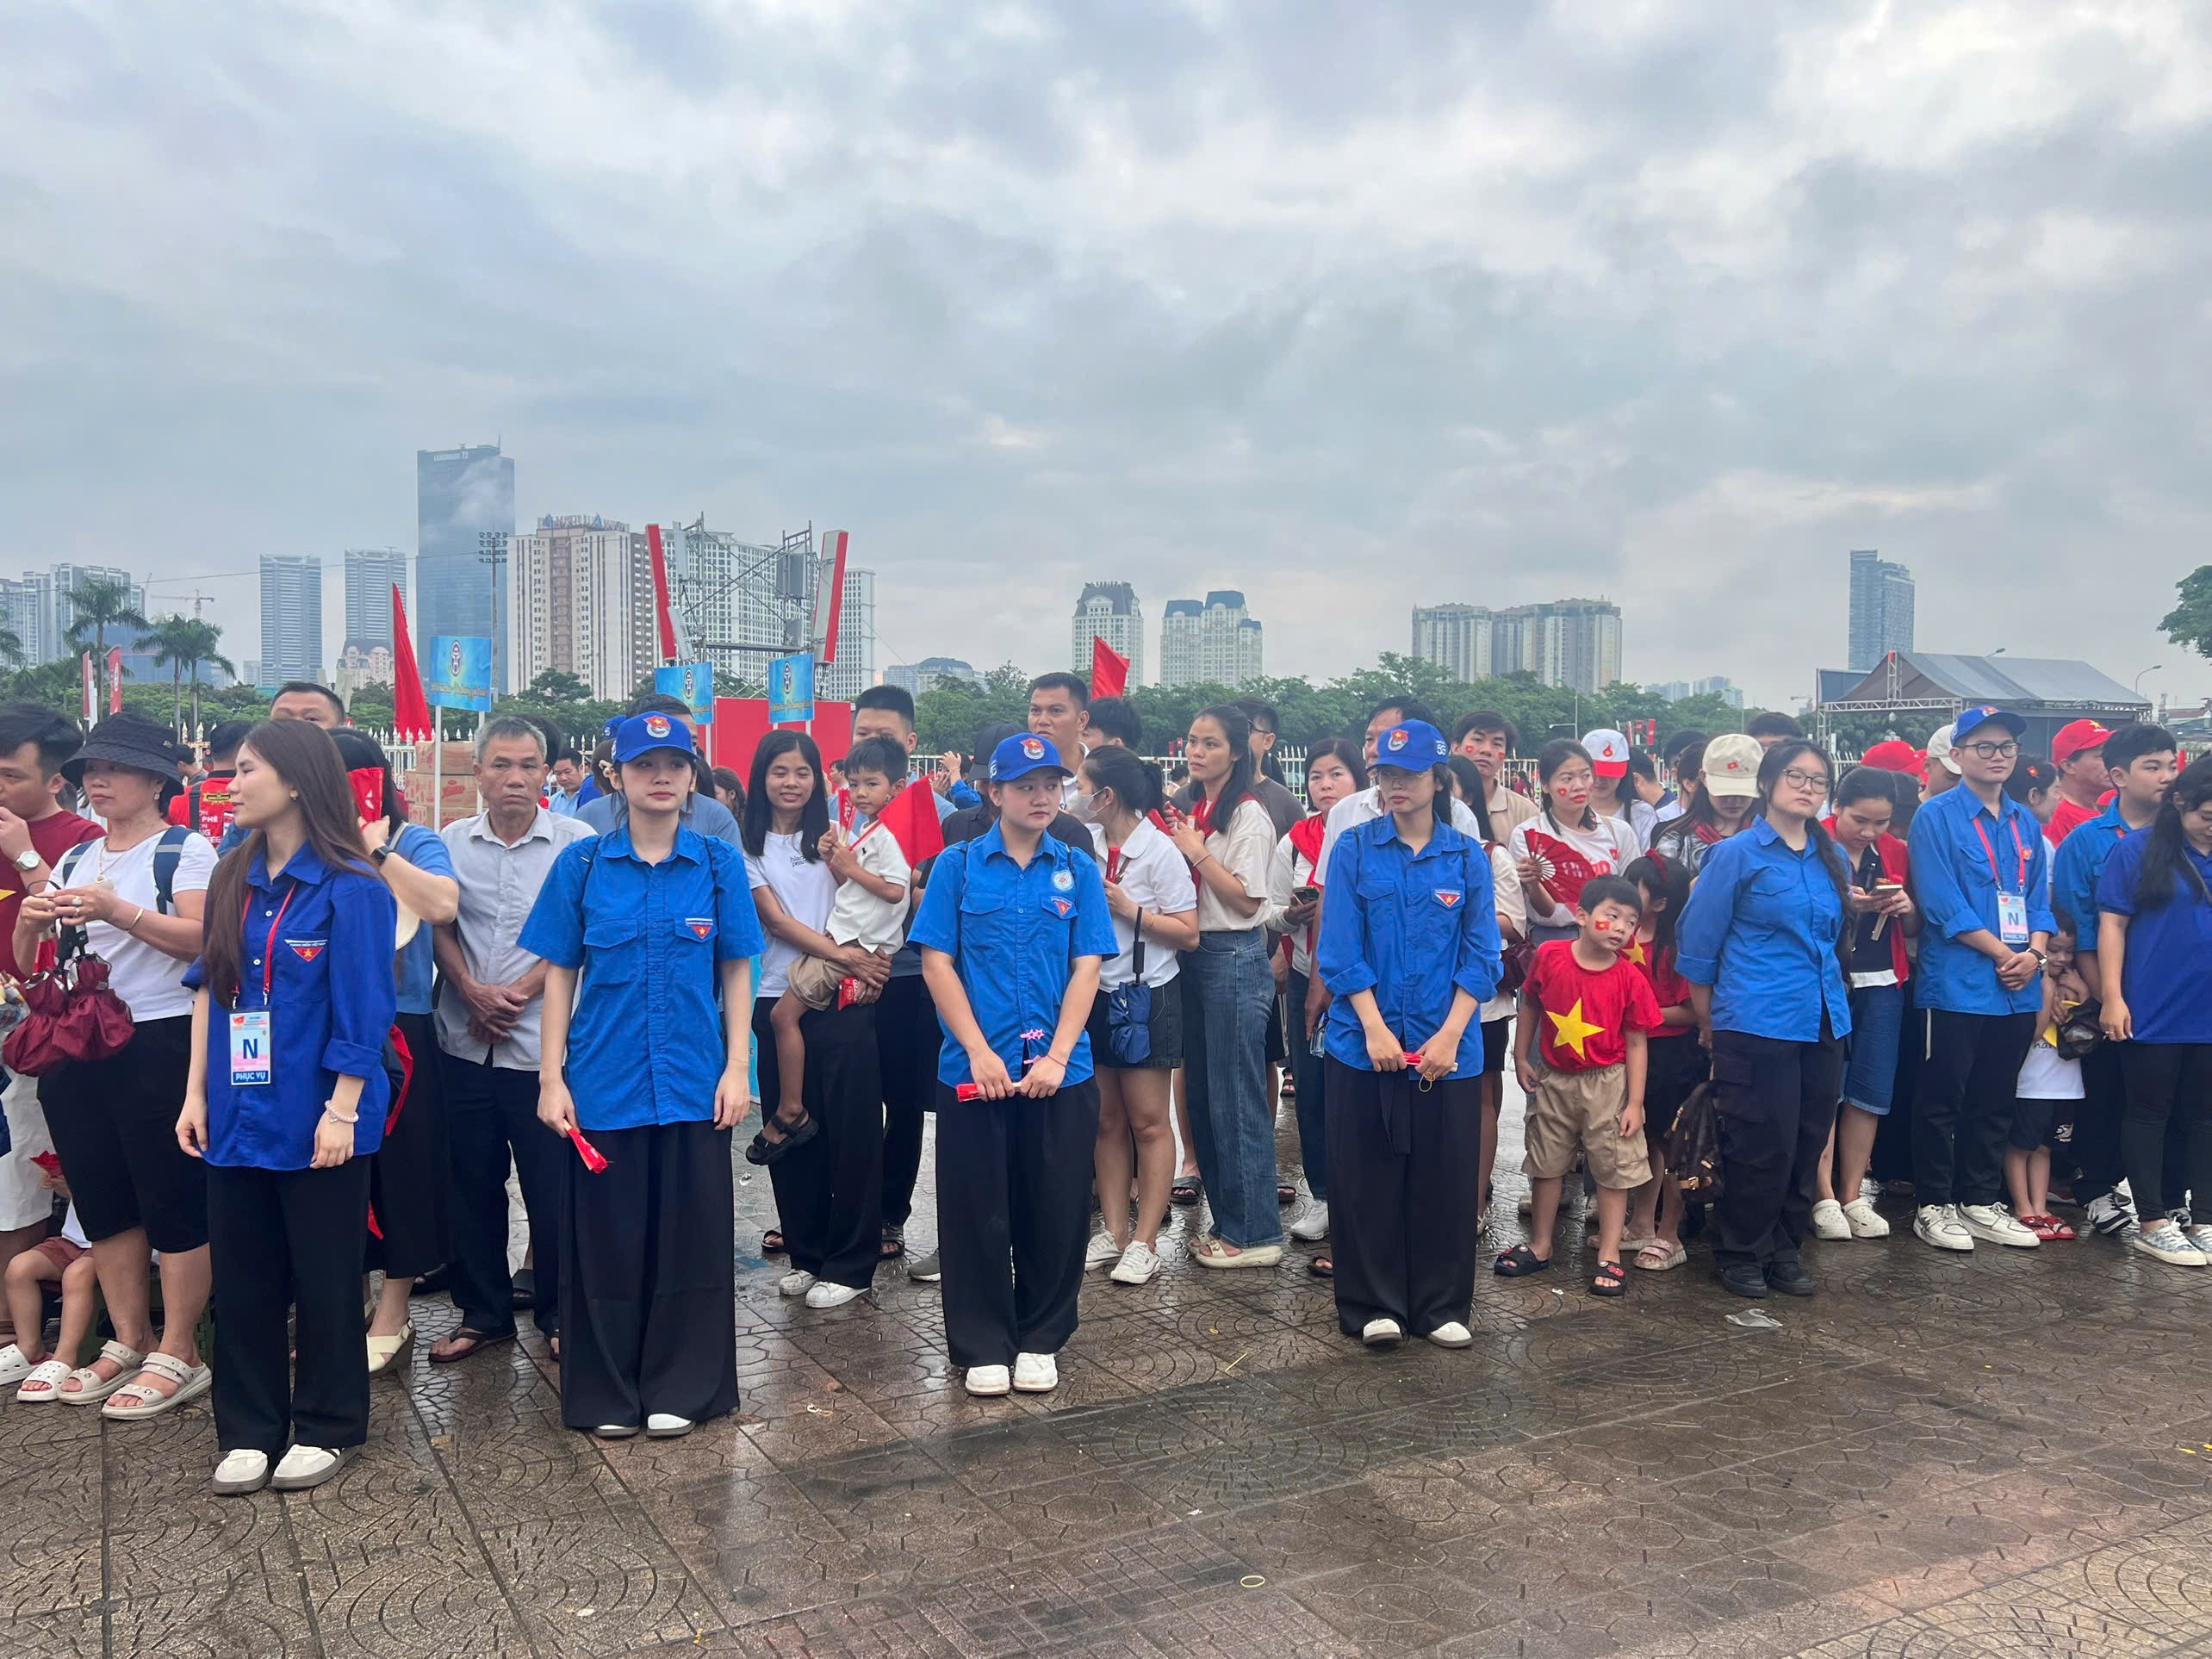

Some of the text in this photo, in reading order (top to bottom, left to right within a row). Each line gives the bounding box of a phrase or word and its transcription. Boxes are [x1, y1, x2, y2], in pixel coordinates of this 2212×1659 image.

[2008, 912, 2019, 926] N
[243, 1039, 258, 1059] N
[235, 1072, 266, 1082] PHỤC VỤ
